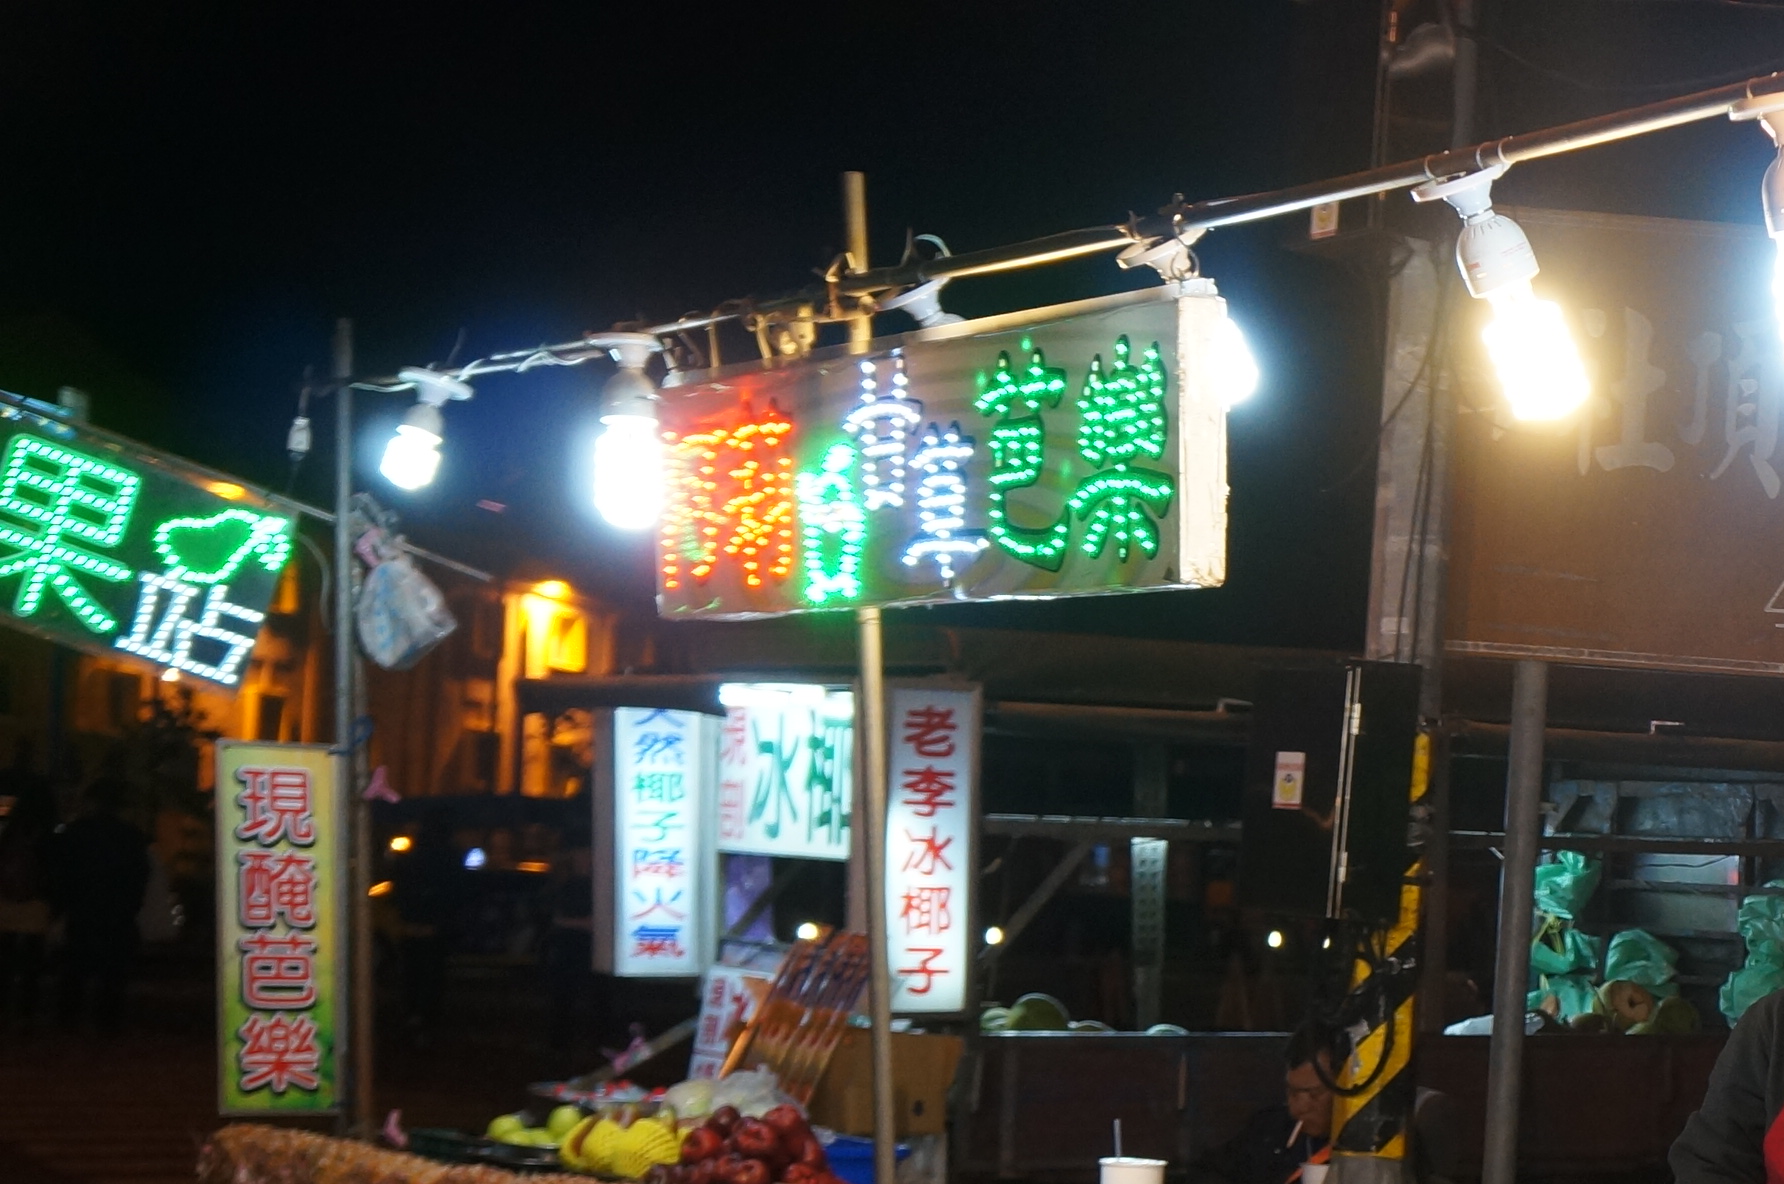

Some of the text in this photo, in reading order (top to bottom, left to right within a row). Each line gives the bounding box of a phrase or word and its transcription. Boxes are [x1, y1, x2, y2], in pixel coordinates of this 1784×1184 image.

[236, 765, 321, 1095] 現醃芭樂
[898, 704, 958, 997] 老李冰椰子
